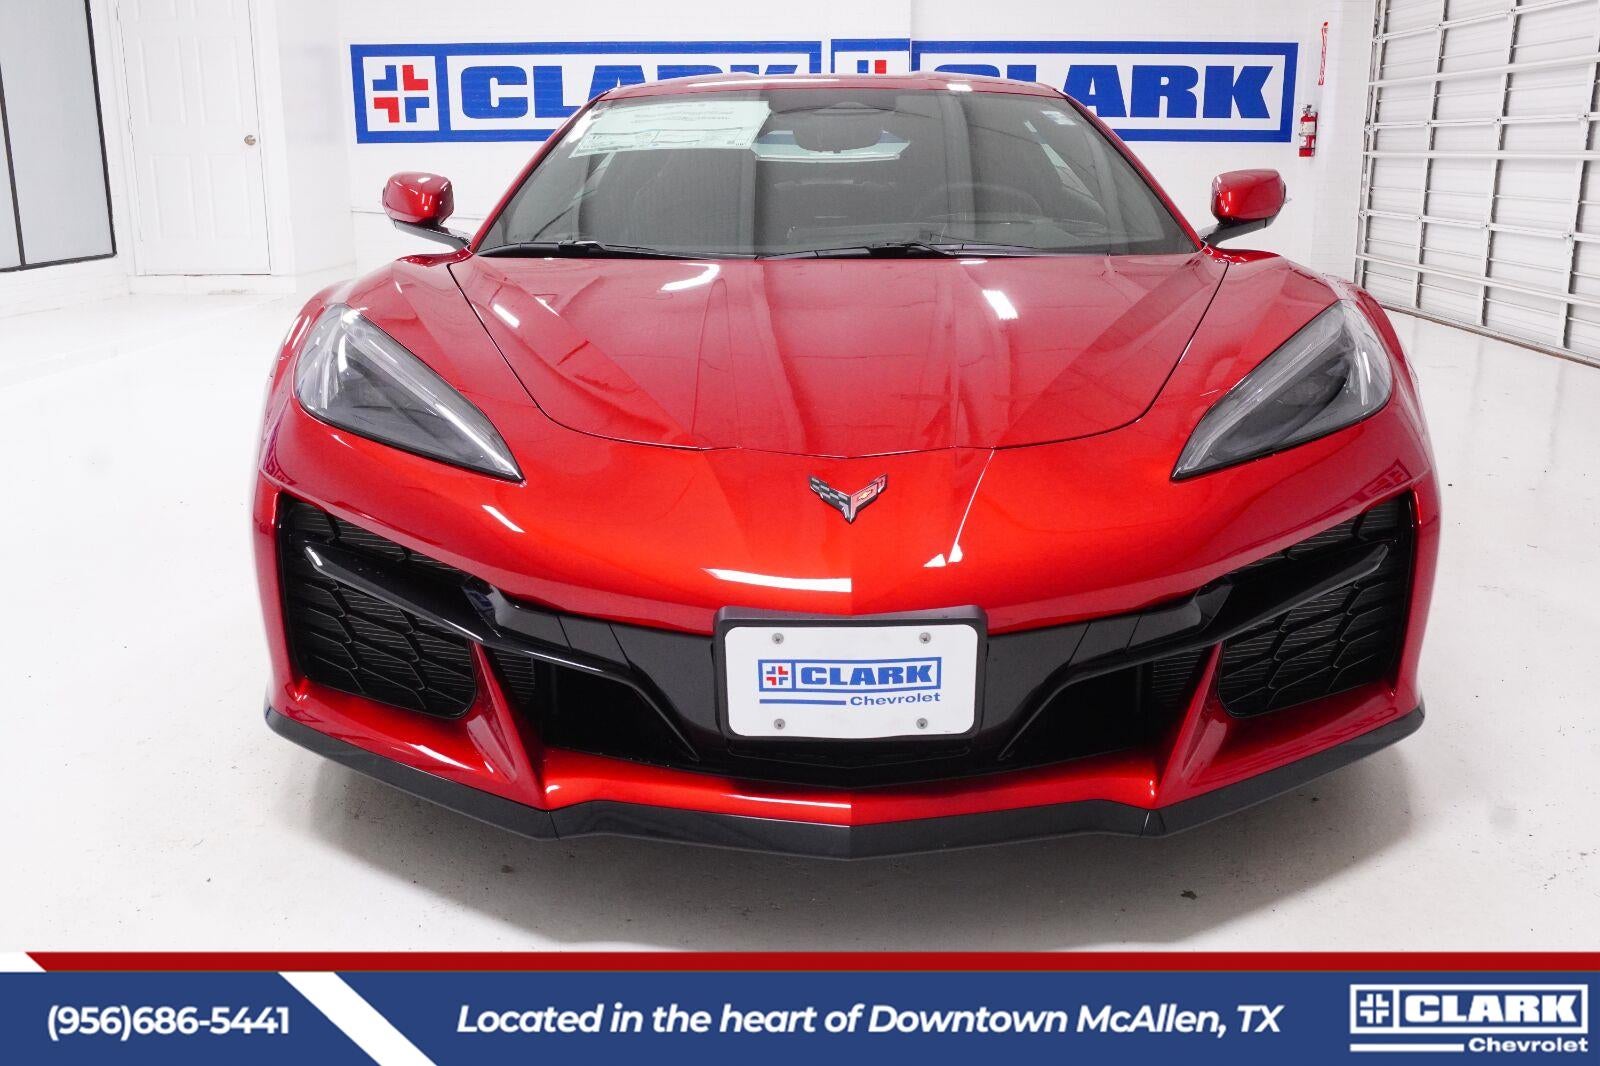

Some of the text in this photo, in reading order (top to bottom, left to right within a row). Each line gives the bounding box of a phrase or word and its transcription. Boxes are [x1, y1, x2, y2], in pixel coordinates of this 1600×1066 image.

[933, 63, 1274, 120] ARK
[800, 664, 932, 687] CLARK
[849, 692, 941, 707] Chevrolet
